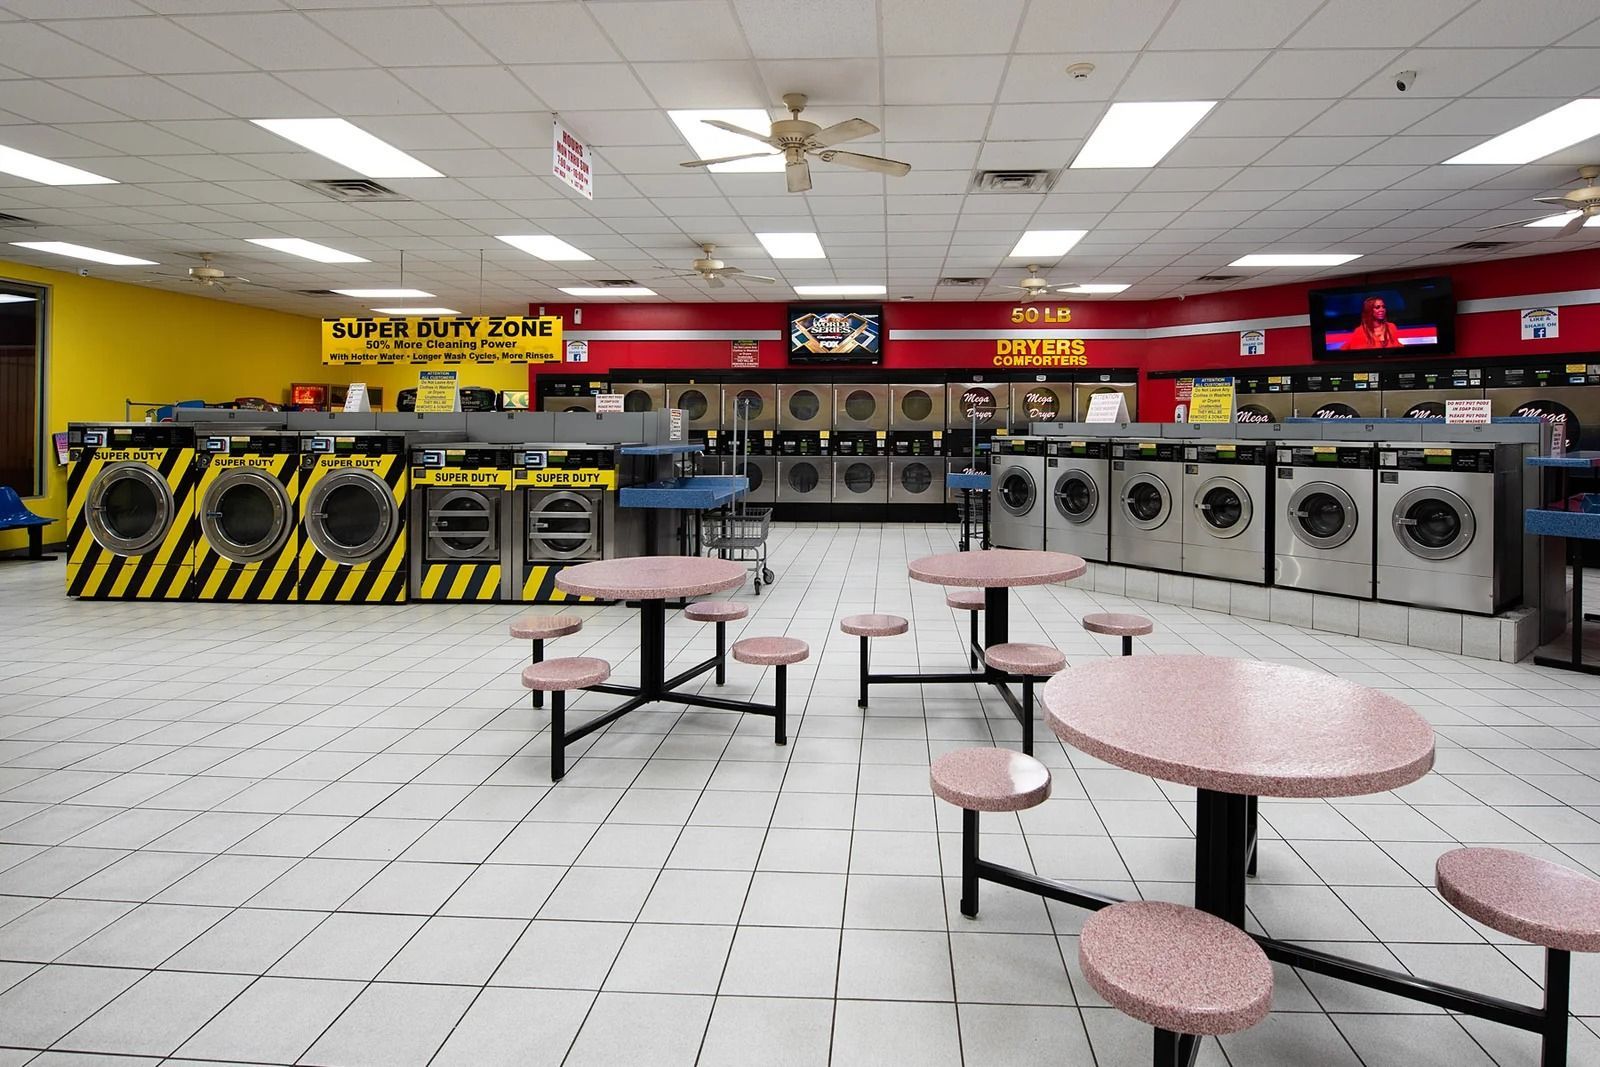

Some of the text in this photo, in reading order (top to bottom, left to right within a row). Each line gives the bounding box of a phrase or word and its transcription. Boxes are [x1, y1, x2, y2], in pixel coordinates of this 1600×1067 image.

[563, 130, 583, 157] HOURS
[1011, 307, 1072, 324] 50 LB
[332, 320, 553, 339] SUPER DUTY ZONE
[366, 339, 517, 351] 50% More Cleaning Power
[820, 340, 840, 348] FOX
[997, 339, 1085, 355] DRYERS
[413, 352, 441, 361] Longer
[444, 352, 467, 360] Wash
[469, 352, 499, 361] Cycles,
[502, 352, 523, 360] More
[525, 352, 554, 360] Rinses
[993, 355, 1088, 366] COMFORTERS
[963, 393, 990, 404] Mega
[1026, 393, 1053, 404] Mega
[966, 408, 992, 420] Dryer
[1029, 408, 1055, 420] Dryer
[1237, 410, 1269, 423] Mega
[1518, 407, 1568, 424] Mega
[94, 452, 163, 461] SUPER DUTY
[215, 459, 275, 468] SUPER DUTY
[321, 459, 382, 468] SUPER DUTY
[435, 473, 499, 482] SUPER DUTY
[536, 473, 600, 483] SUPER DUTY
